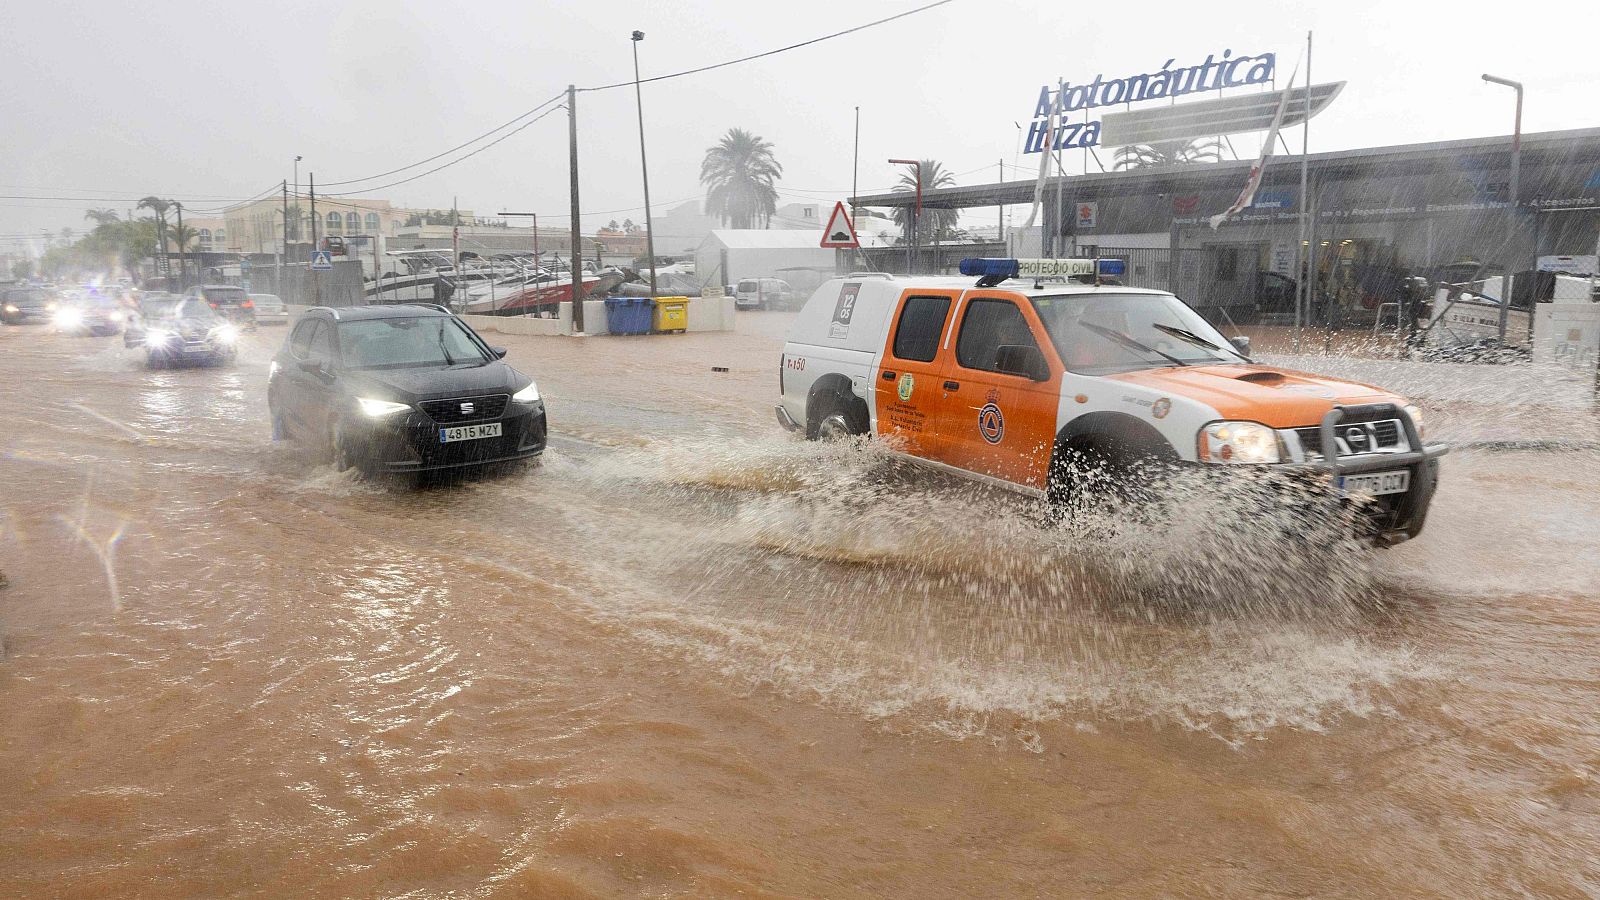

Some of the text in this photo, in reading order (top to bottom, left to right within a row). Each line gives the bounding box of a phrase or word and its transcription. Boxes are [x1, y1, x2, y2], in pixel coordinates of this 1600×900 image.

[1034, 49, 1275, 118] Motonáutica
[1072, 262, 1093, 274] CIVIL
[448, 424, 499, 439] 4815 MZY
